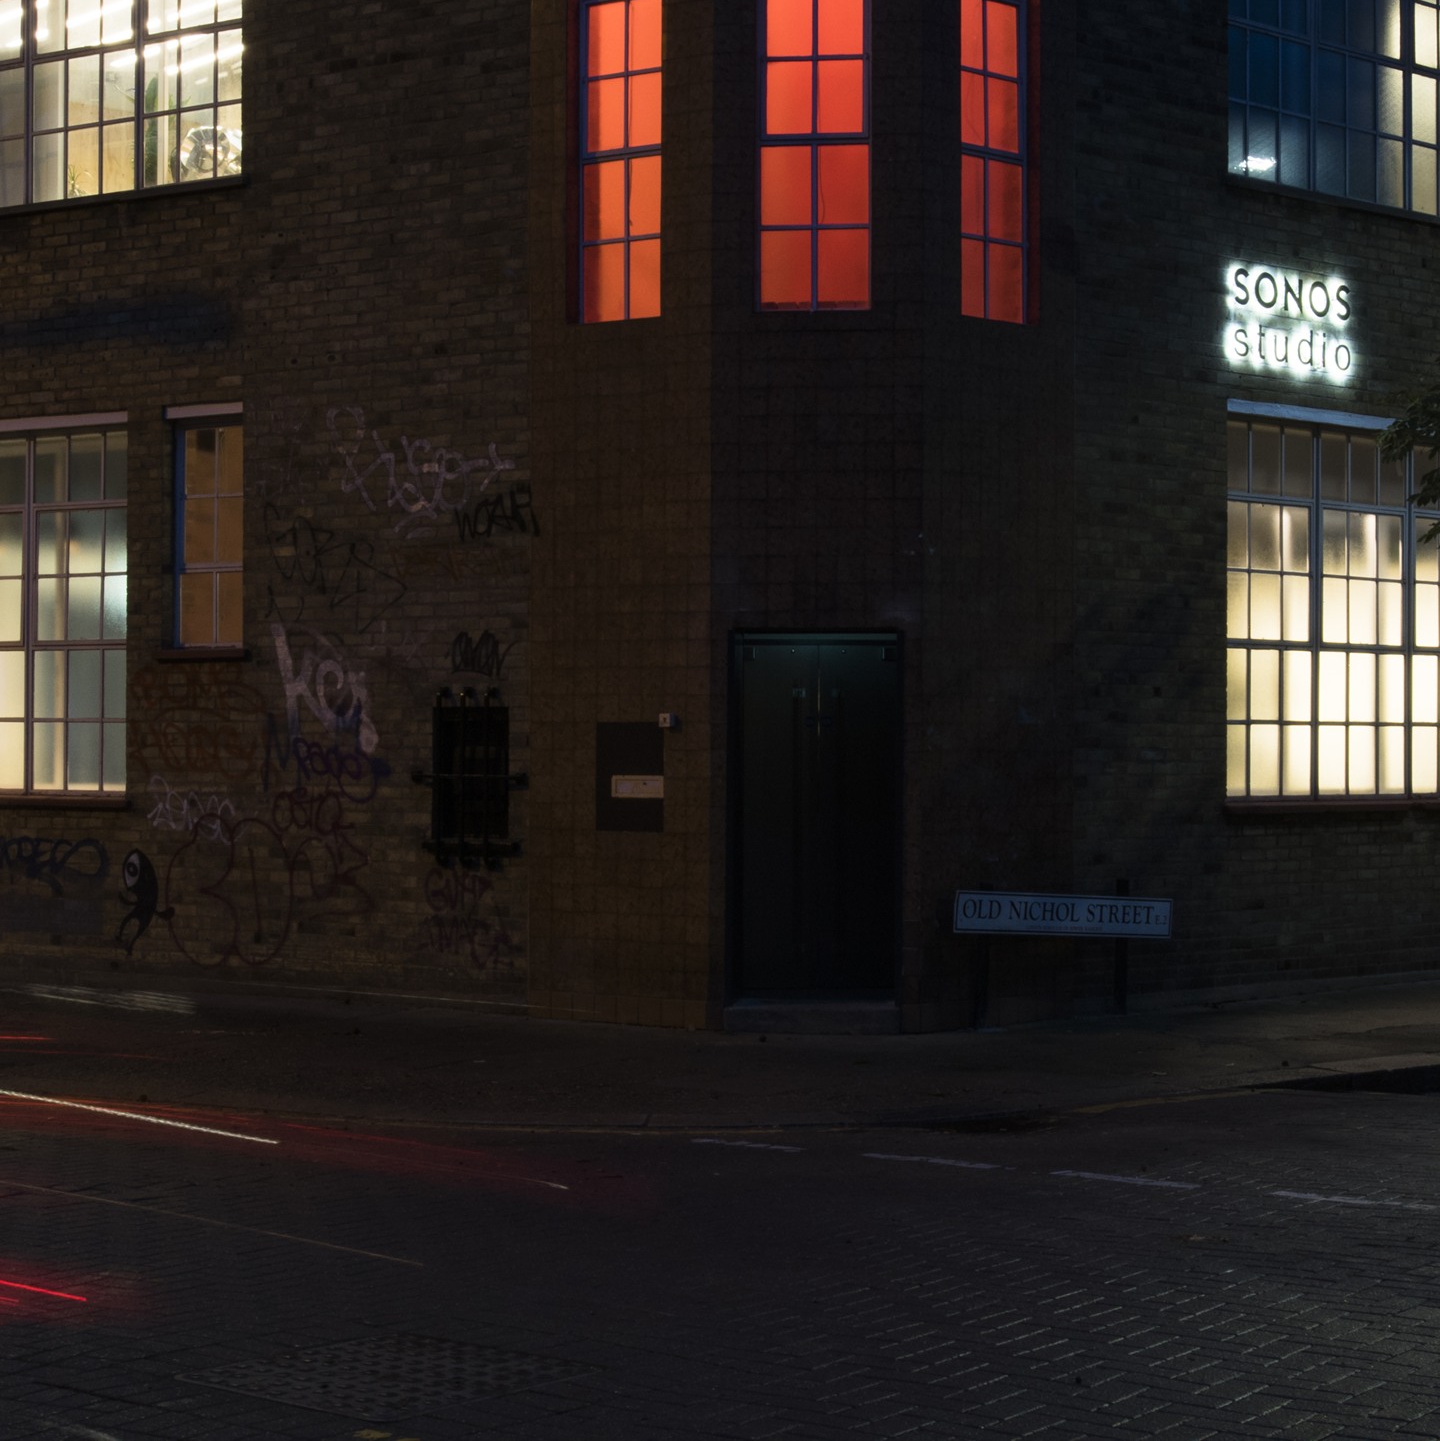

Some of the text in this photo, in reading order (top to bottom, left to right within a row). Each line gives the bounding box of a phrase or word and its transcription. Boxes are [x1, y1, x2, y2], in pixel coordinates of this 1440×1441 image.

[1233, 267, 1351, 321] SONOS
[1233, 324, 1351, 371] studio
[963, 899, 1001, 919] OLD
[1008, 900, 1080, 922] NICHOL
[1086, 903, 1154, 924] STREET
